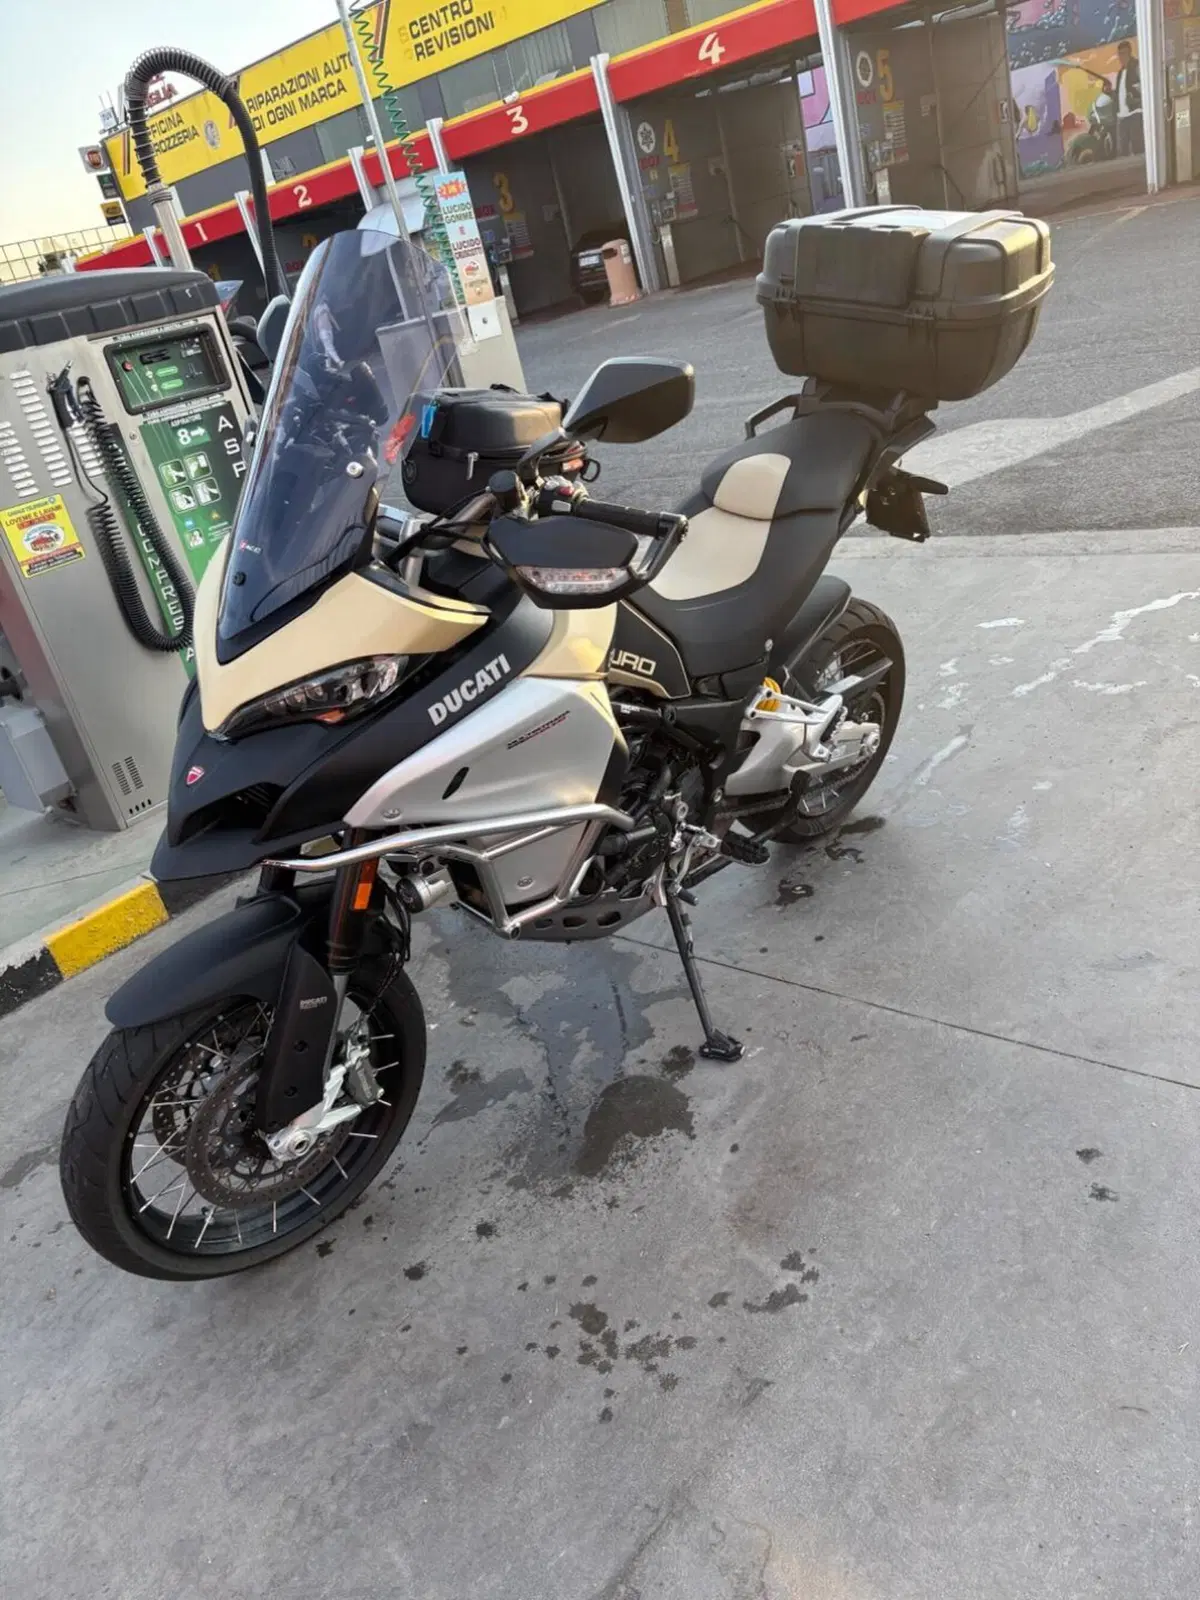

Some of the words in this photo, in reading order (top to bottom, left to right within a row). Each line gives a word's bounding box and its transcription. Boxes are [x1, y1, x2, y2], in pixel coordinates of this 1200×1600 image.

[408, 0, 474, 40] CENTRO
[413, 11, 495, 61] REVISIONI
[698, 32, 725, 65] 4
[246, 67, 321, 113] RIPARAZIONI
[876, 49, 894, 101] 5
[252, 115, 266, 132] DI
[266, 101, 297, 126] OGNI
[298, 79, 347, 112] MARCA
[505, 105, 529, 134] 3
[153, 125, 200, 156] ROZZERIA
[662, 119, 680, 163] 4
[293, 185, 312, 208] 2
[442, 202, 472, 215] LUCIDO
[194, 222, 208, 241] 1
[444, 211, 474, 225] GOMME
[451, 238, 481, 251] LUCIDO
[177, 428, 192, 446] 8
[608, 648, 657, 676] URO
[427, 653, 512, 726] DUCATI
